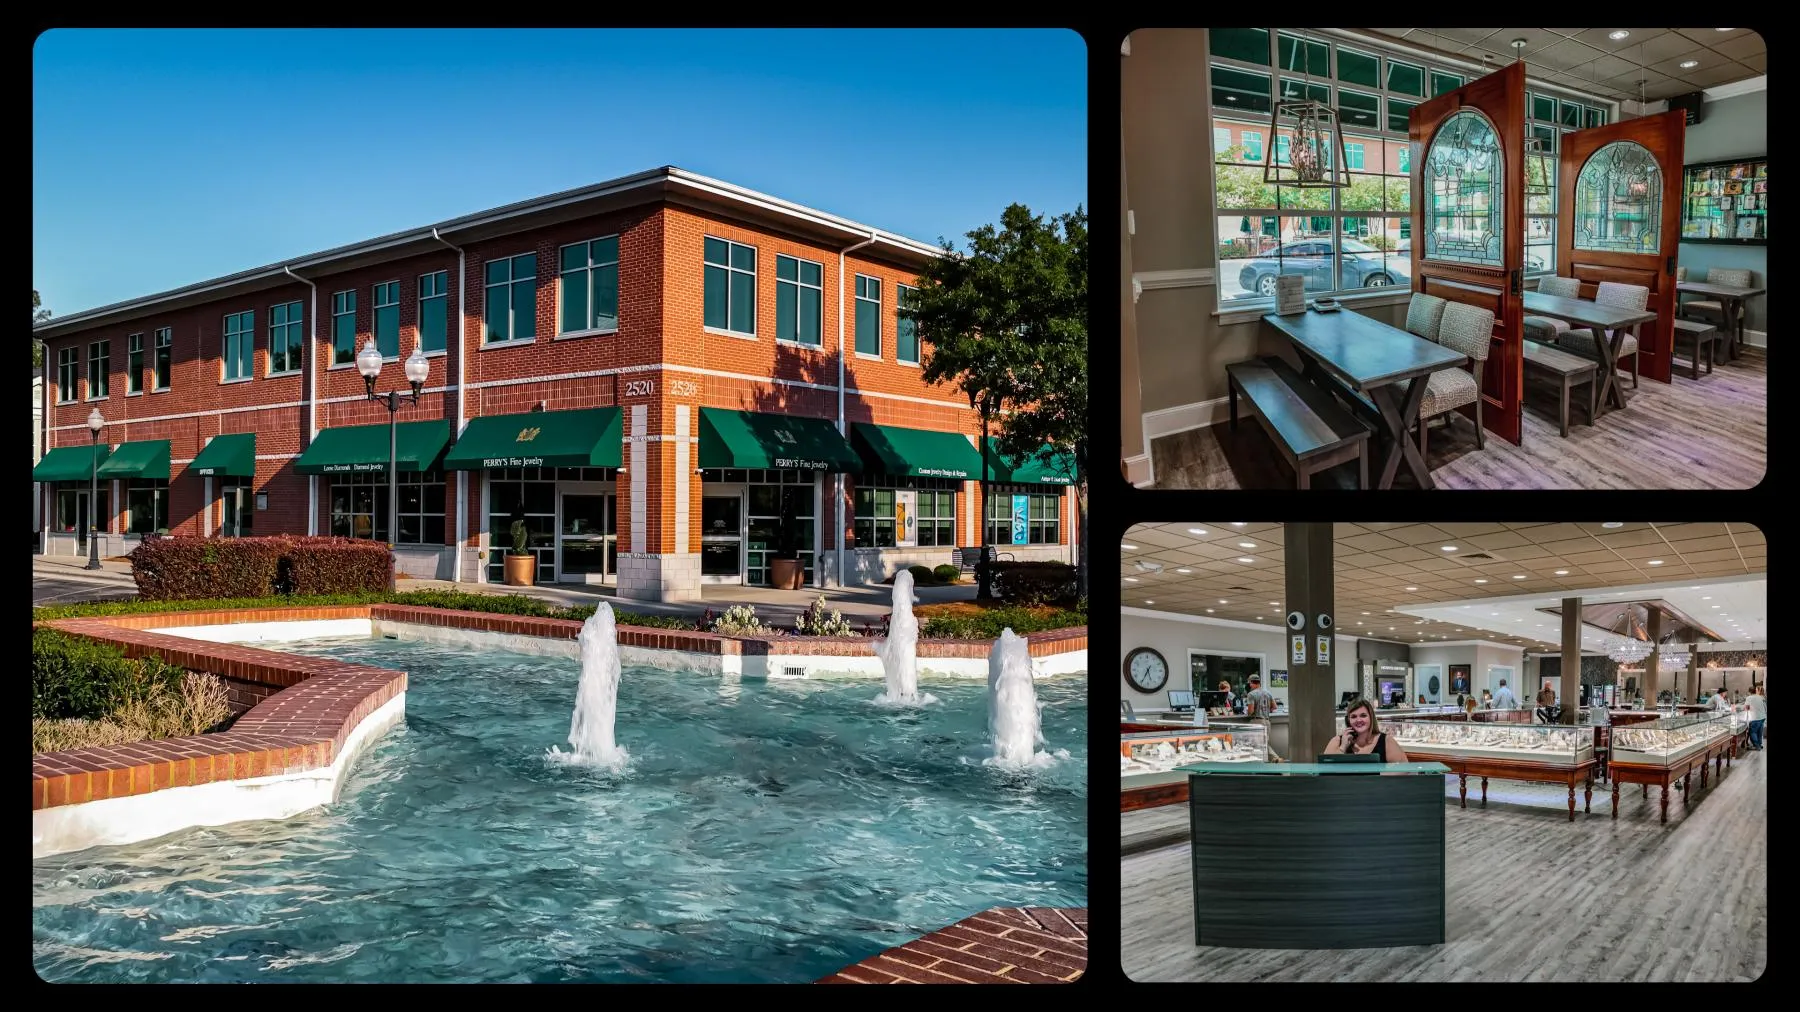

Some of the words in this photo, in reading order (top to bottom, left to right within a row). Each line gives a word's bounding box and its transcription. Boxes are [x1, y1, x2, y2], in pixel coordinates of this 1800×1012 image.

[625, 379, 654, 397] 2520
[370, 463, 384, 471] Jewelry
[483, 458, 508, 467] PERRY'S
[509, 457, 522, 466] Fine
[522, 456, 544, 467] Jewelry
[775, 458, 799, 468] PERRY'S
[799, 459, 811, 468] Fine
[810, 460, 828, 470] Jewelry
